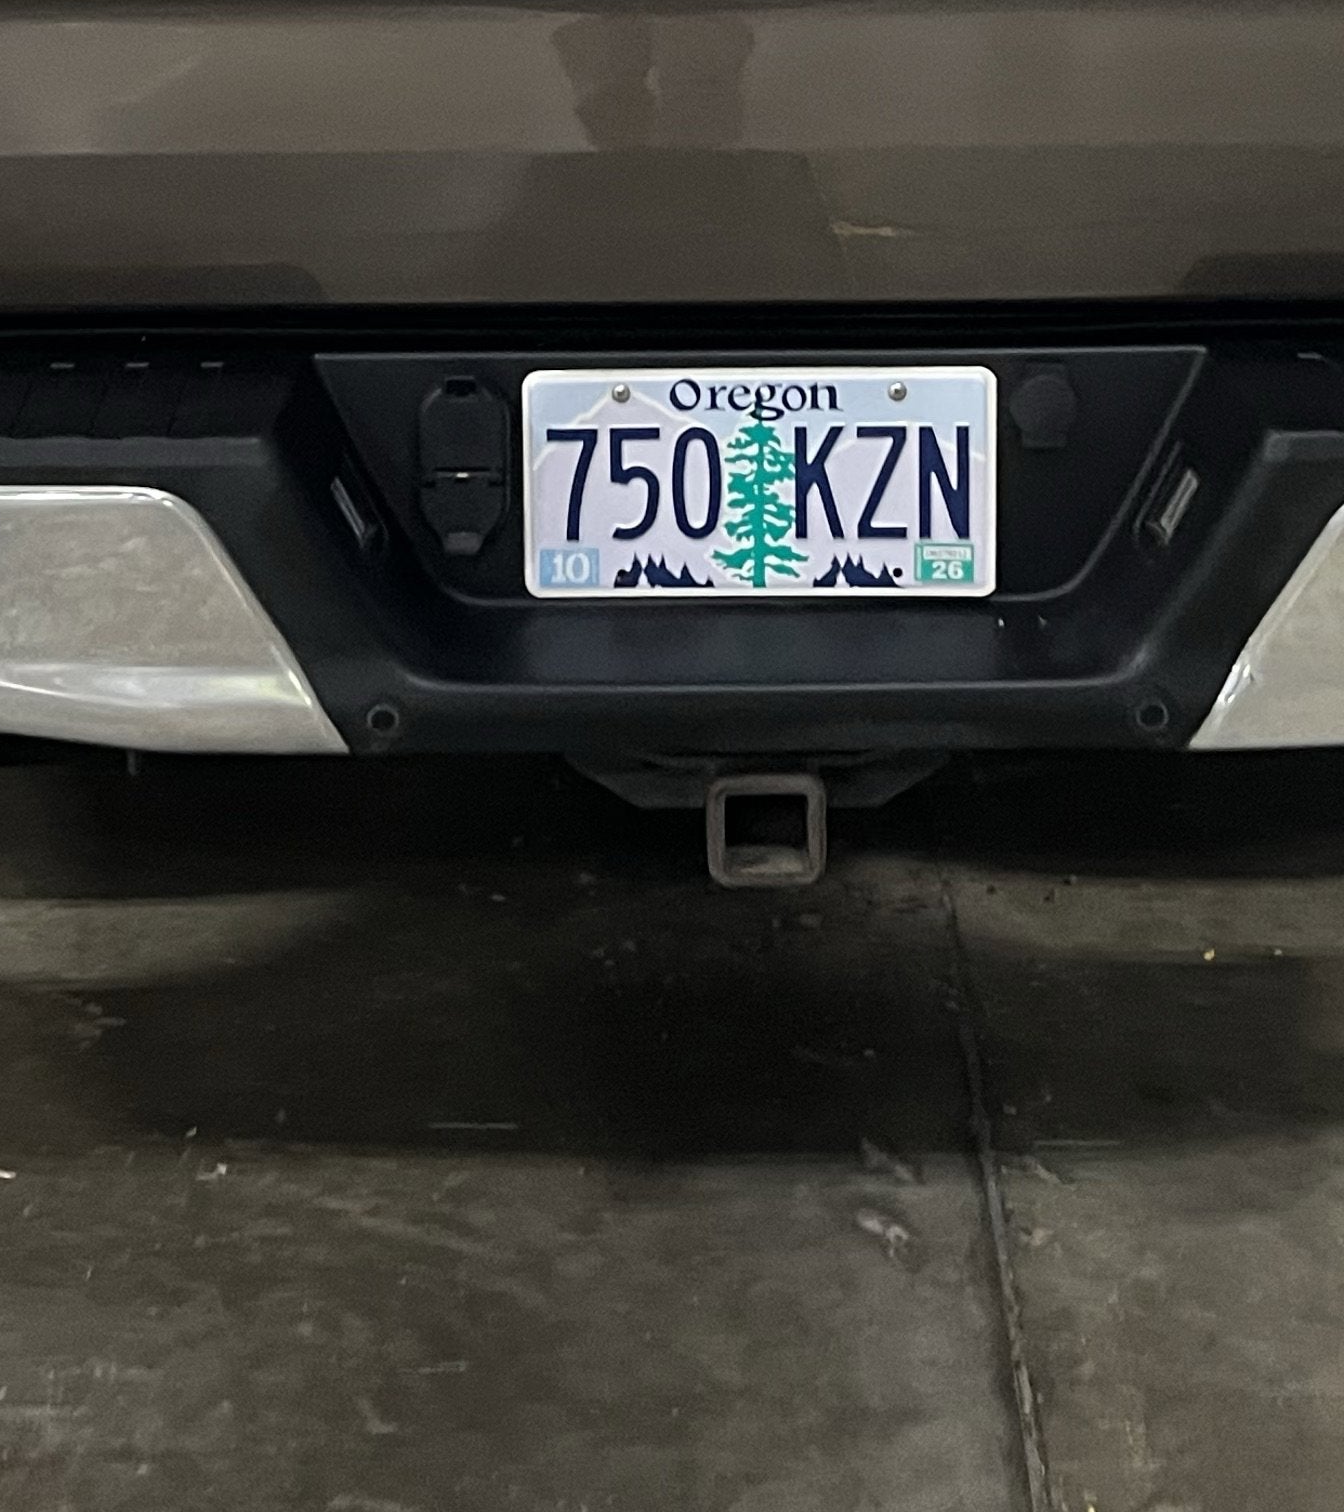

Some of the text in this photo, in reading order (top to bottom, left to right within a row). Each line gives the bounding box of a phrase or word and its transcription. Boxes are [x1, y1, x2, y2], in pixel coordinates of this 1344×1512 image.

[669, 378, 843, 419] Oregon
[546, 425, 971, 541] 750 KZN
[550, 553, 591, 584] 10
[931, 560, 964, 580] 26
